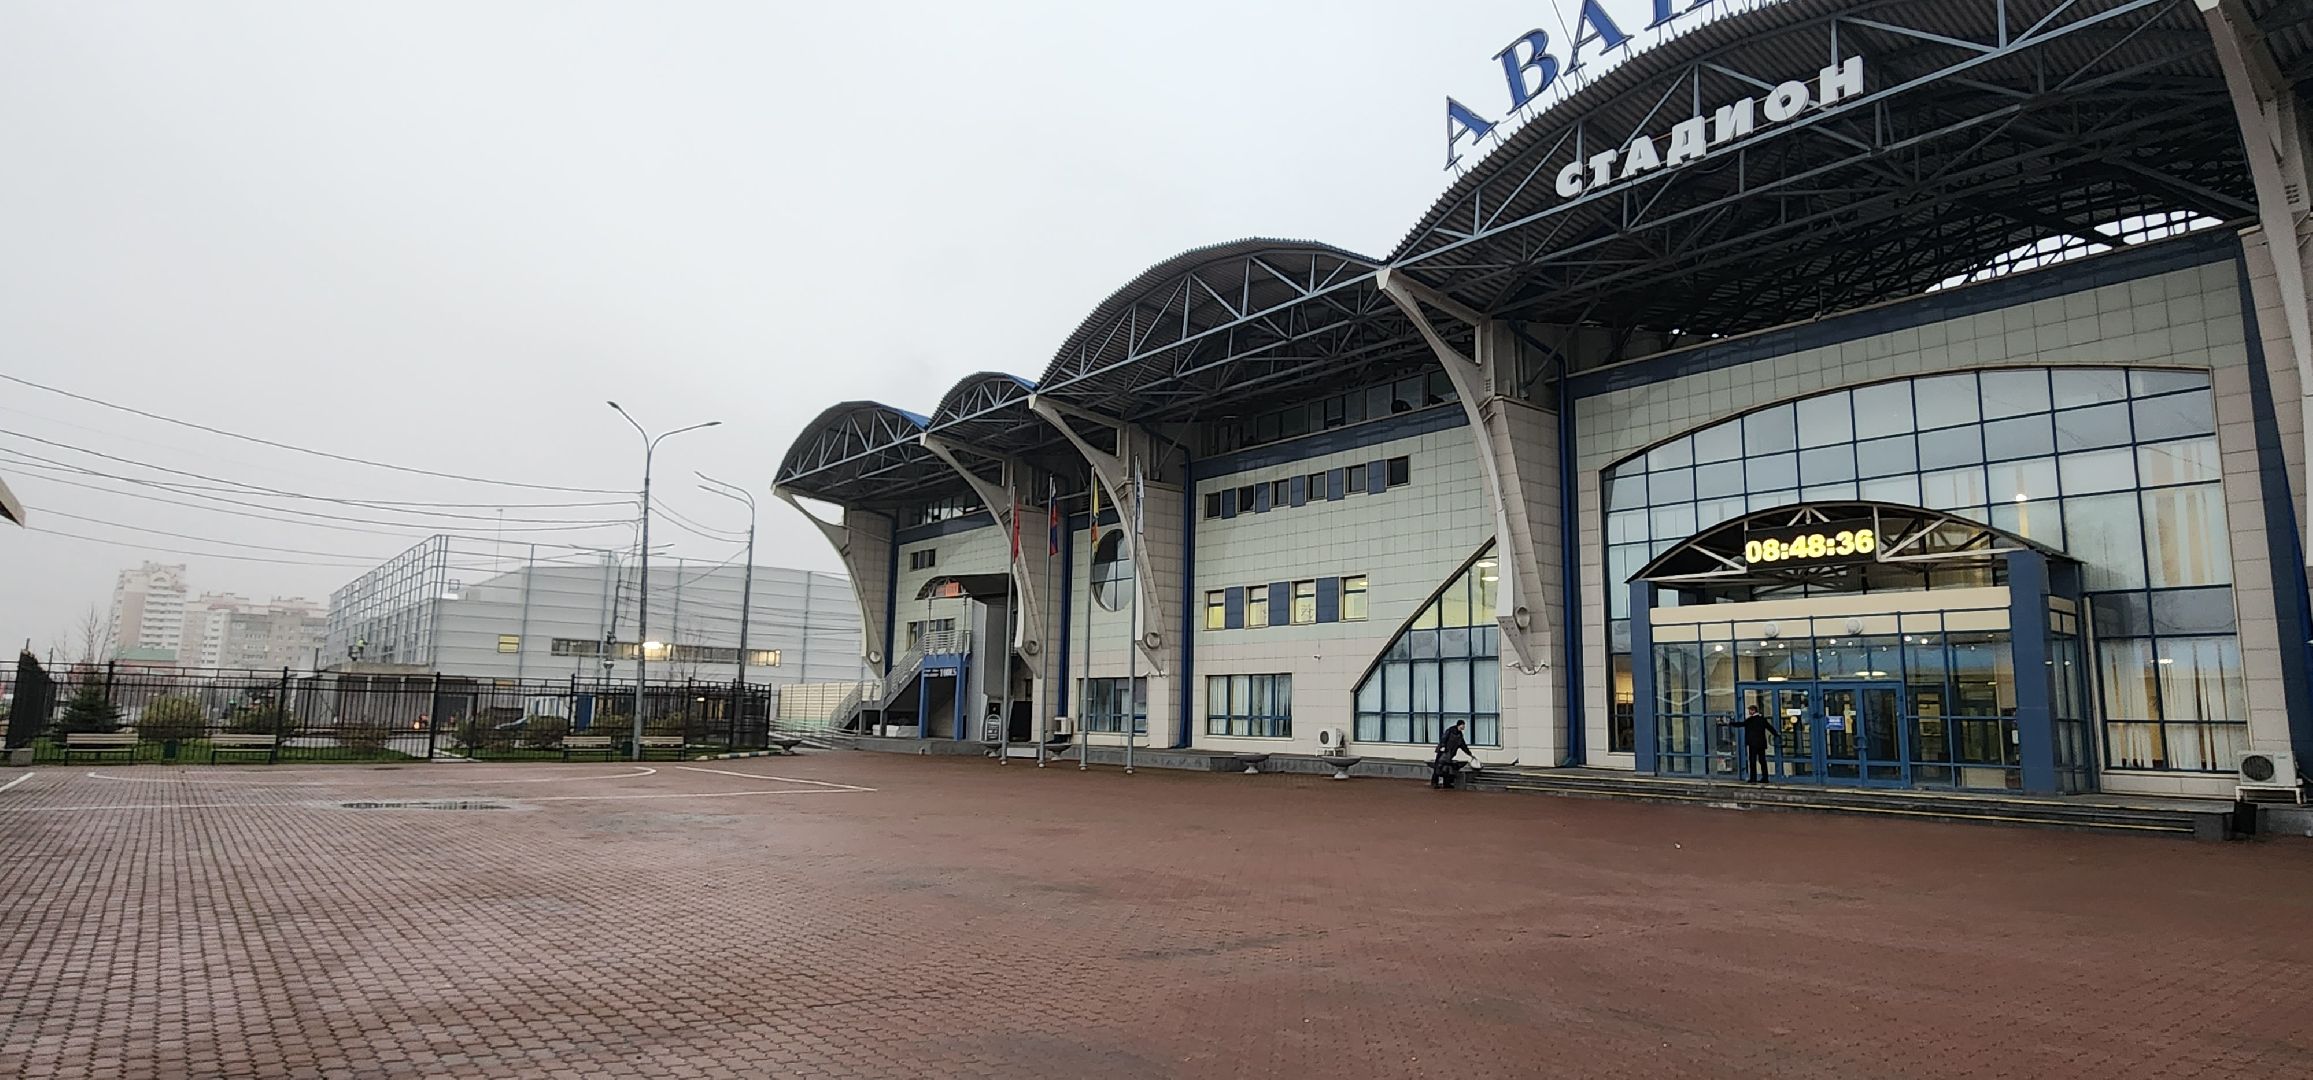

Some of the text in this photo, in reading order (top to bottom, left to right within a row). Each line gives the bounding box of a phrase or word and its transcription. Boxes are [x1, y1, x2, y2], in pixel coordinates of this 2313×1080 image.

[1443, 0, 1713, 171] АВА
[1555, 55, 1864, 198] СТАДИОН
[1745, 528, 1875, 564] 08:48:36
